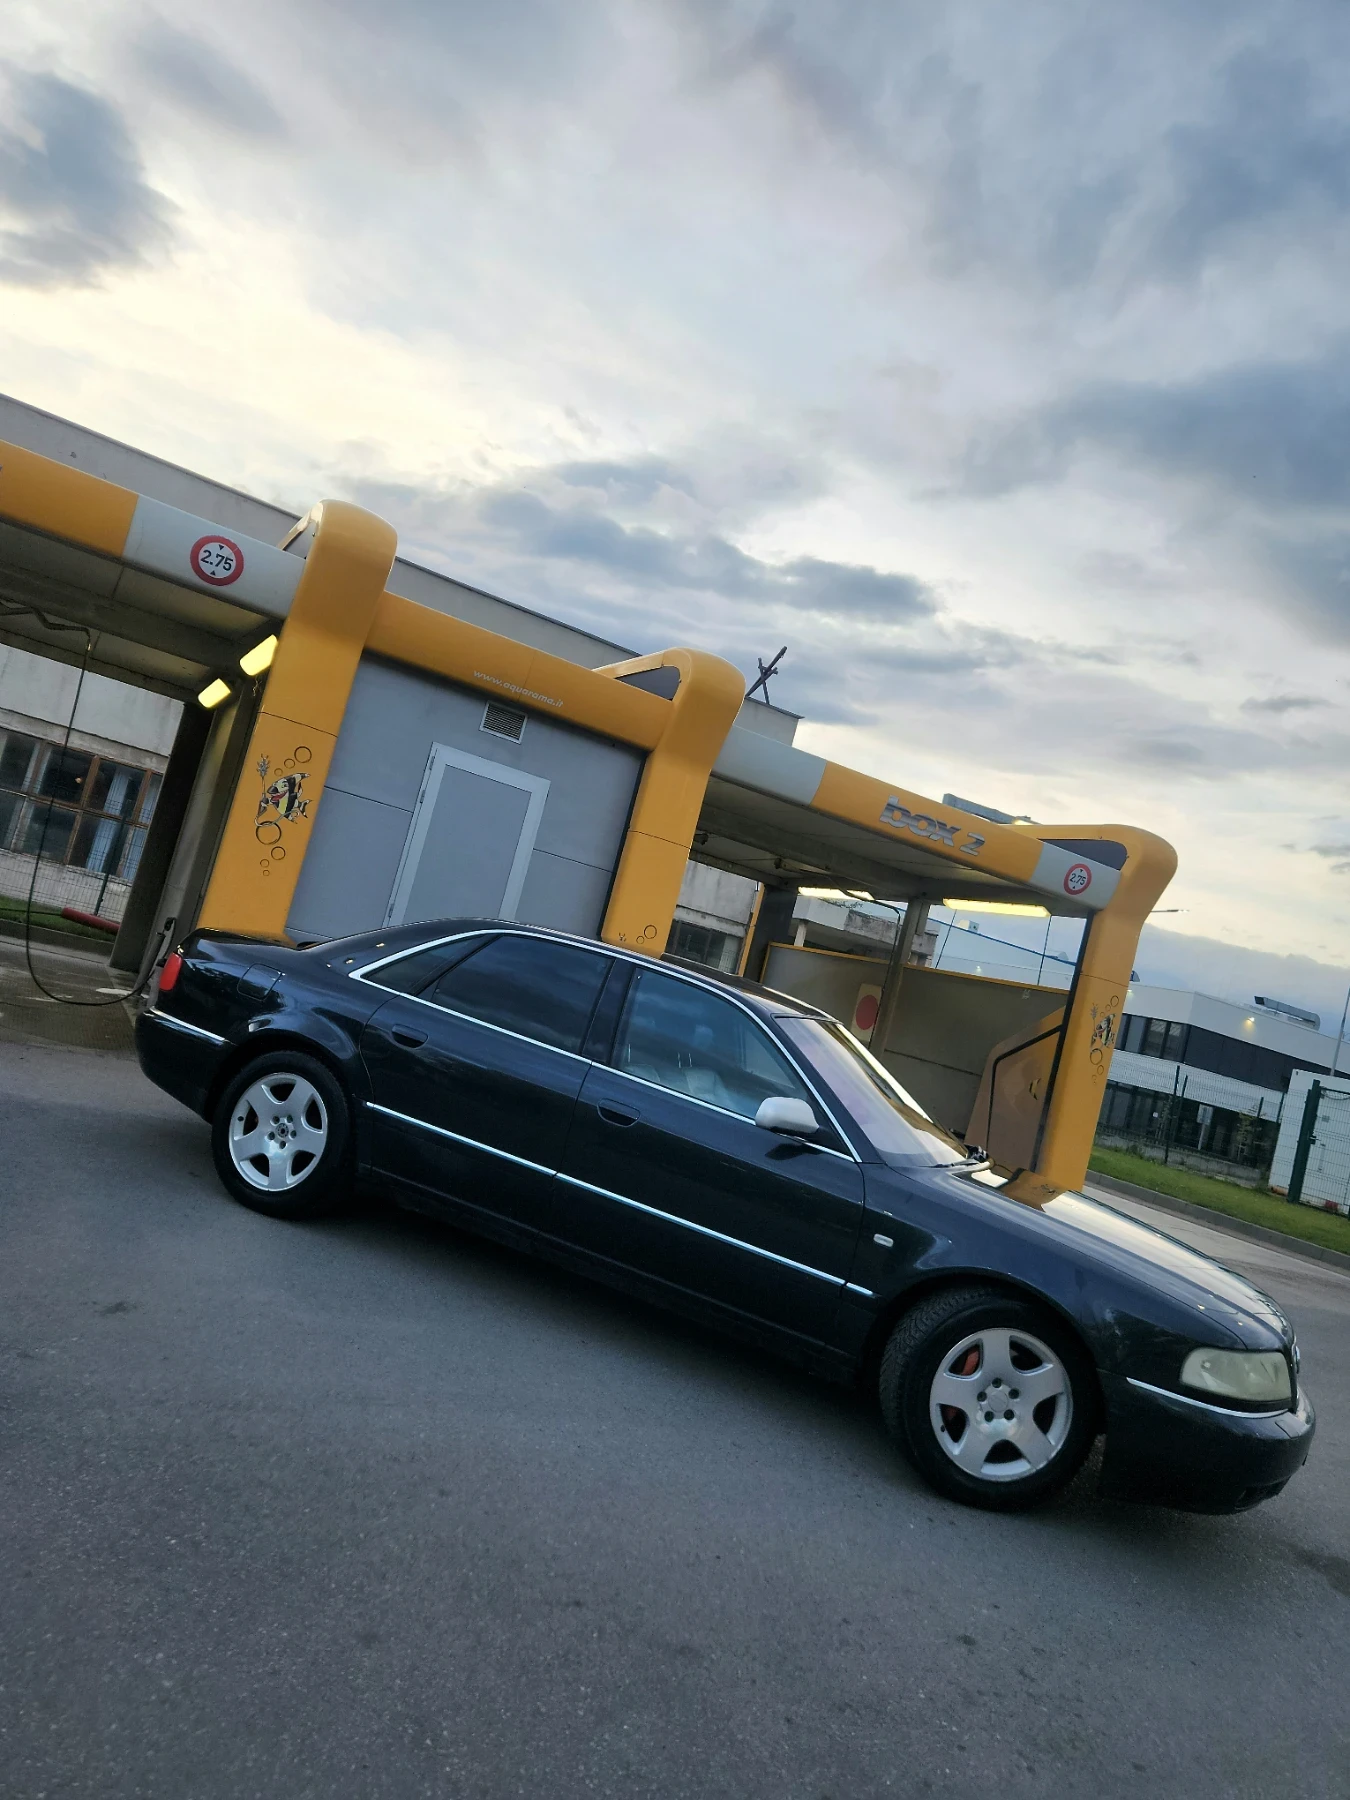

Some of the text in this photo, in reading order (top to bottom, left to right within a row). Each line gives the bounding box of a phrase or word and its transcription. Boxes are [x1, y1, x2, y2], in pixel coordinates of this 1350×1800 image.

[200, 549, 234, 571] 2.75
[473, 670, 564, 708] www.aquarama.it
[879, 794, 985, 856] box 2
[1069, 872, 1087, 886] 2.75
